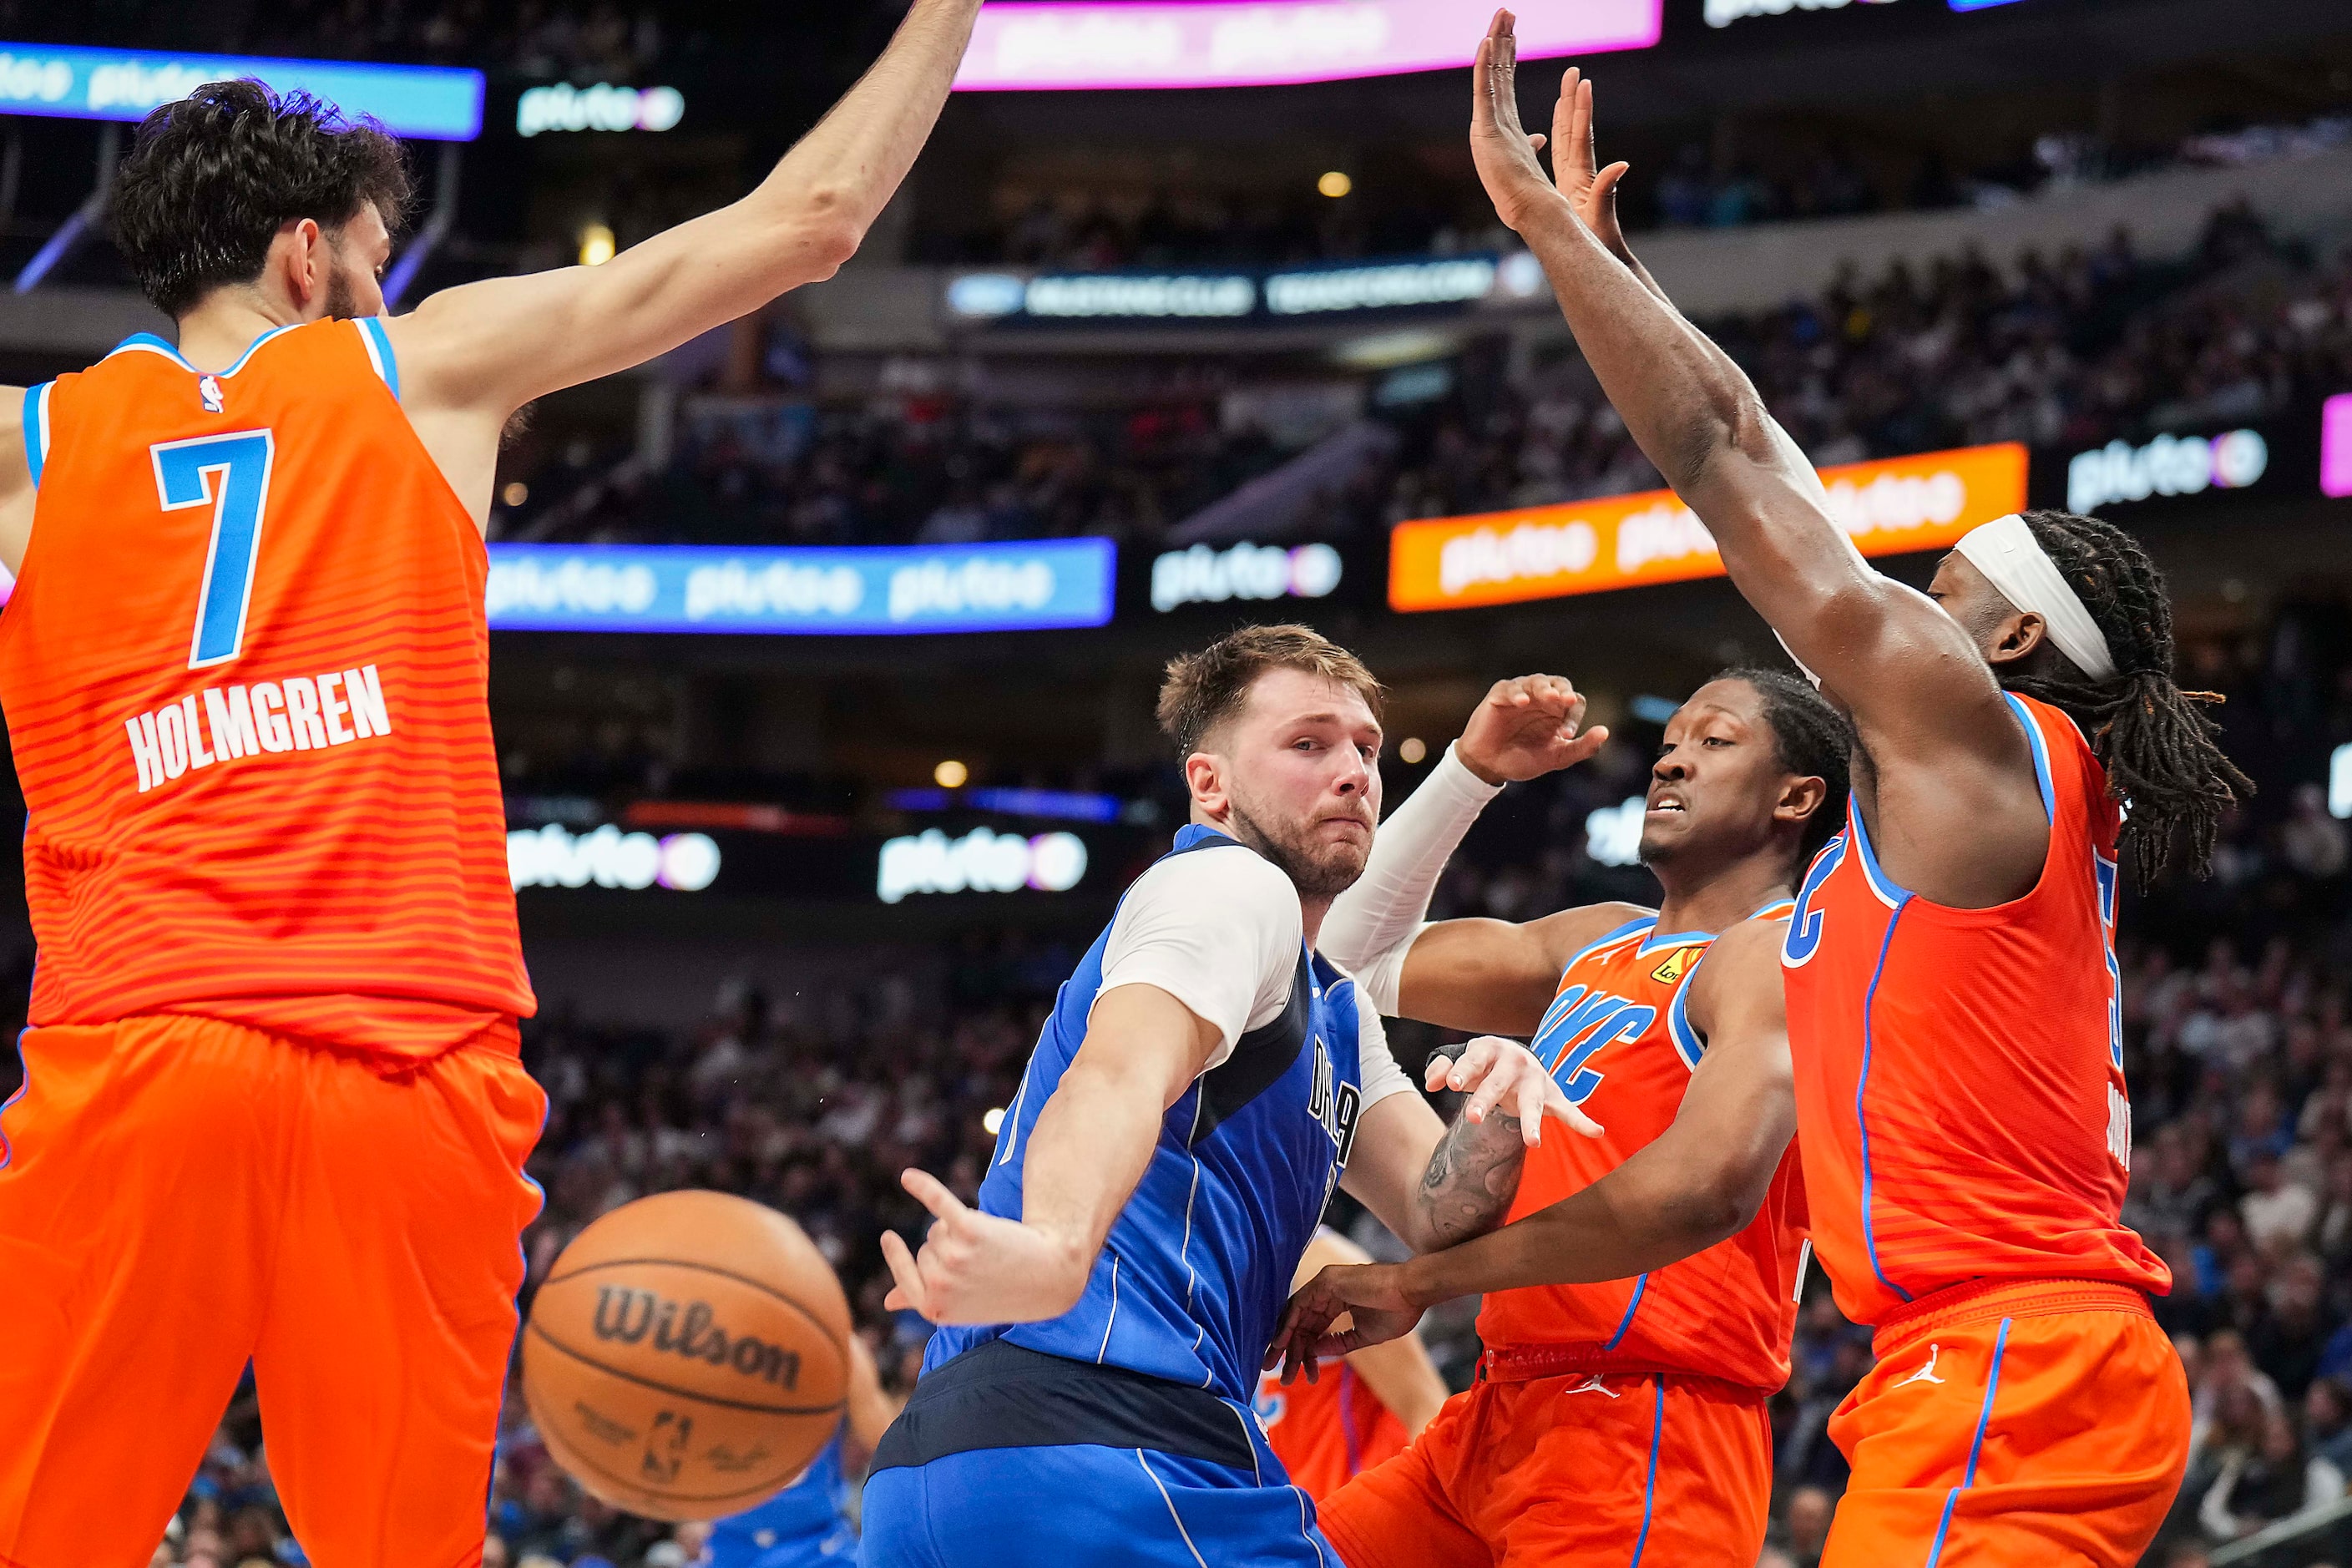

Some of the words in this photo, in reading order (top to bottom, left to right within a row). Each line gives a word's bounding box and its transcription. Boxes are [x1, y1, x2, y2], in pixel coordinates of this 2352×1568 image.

[149, 427, 275, 670] 7
[124, 664, 392, 792] HOLMGREN
[1529, 984, 1657, 1107] OKC
[593, 1285, 800, 1393] Wilson
